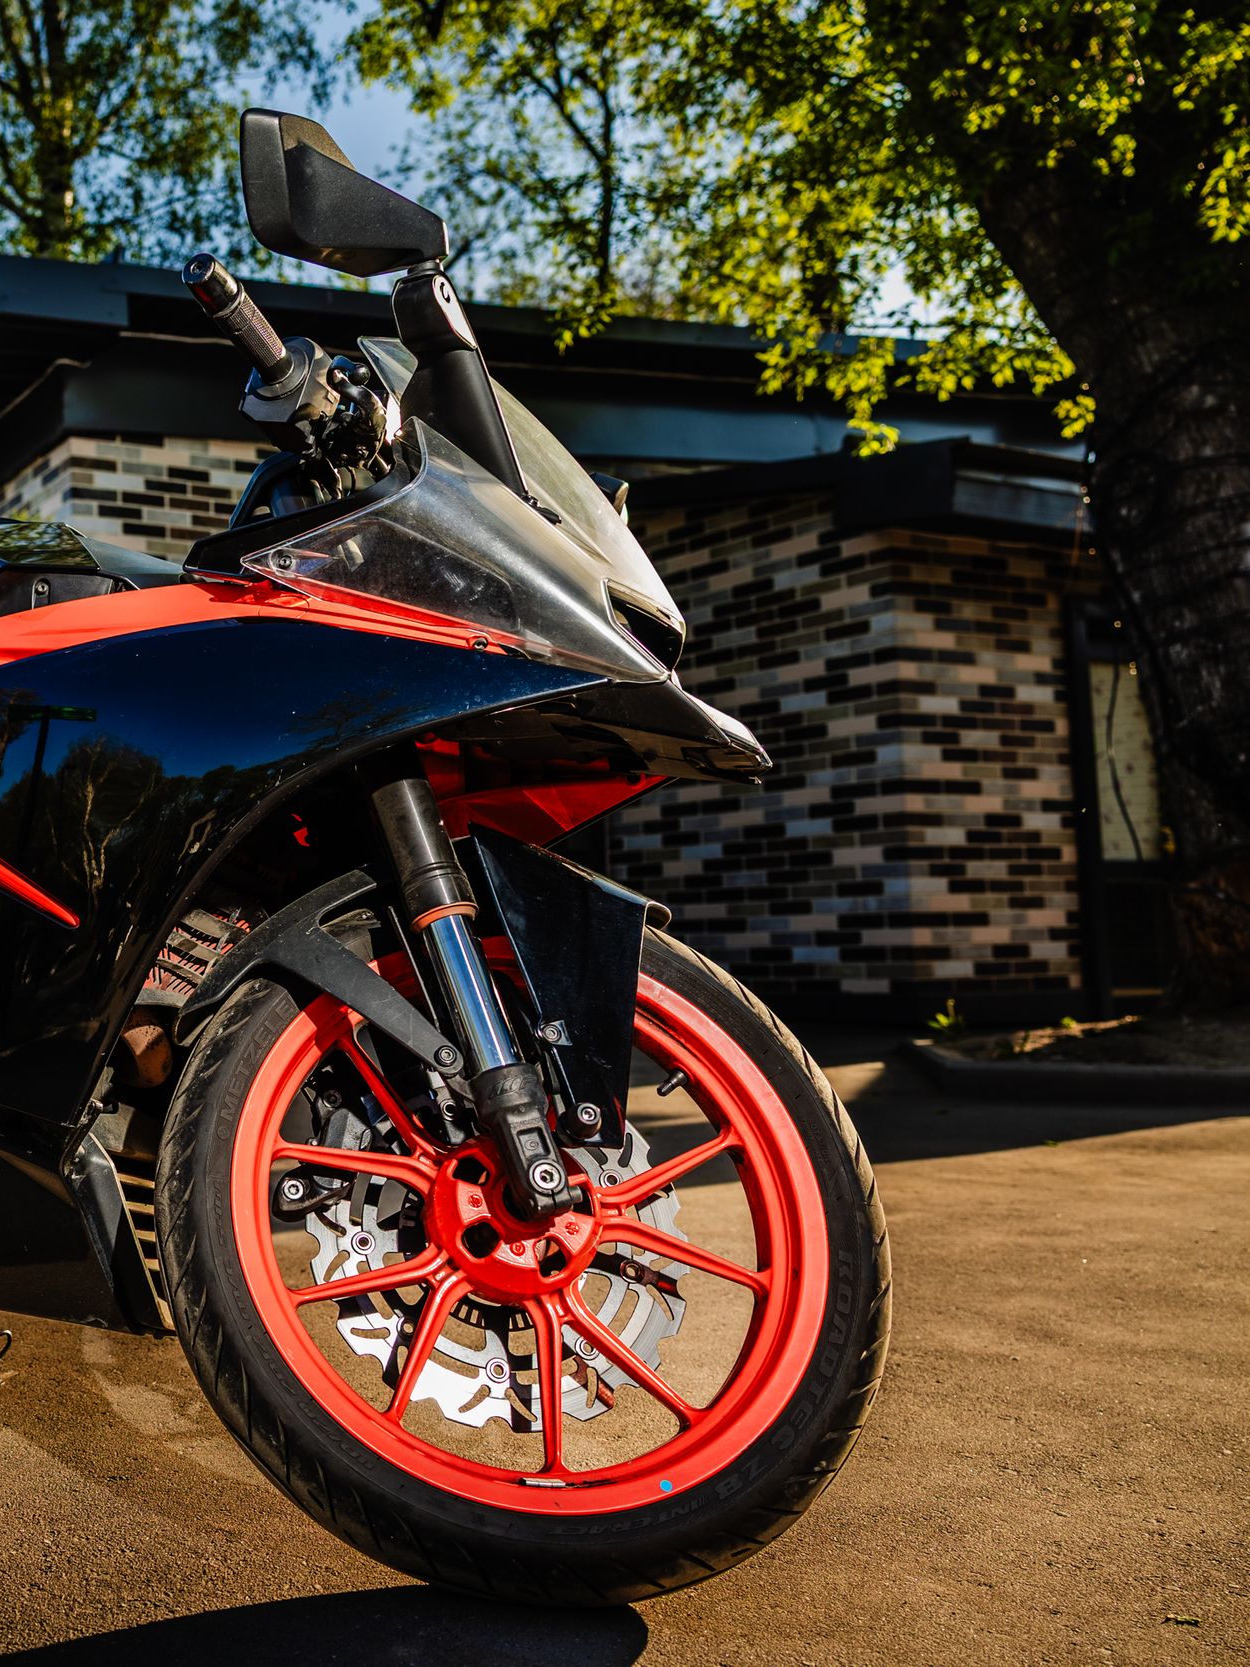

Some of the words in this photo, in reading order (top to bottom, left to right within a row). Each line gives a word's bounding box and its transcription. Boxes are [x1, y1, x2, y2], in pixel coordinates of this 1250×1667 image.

[217, 994, 299, 1122] METZELE
[768, 1247, 856, 1453] ROADTEC
[711, 1453, 769, 1501] Z8
